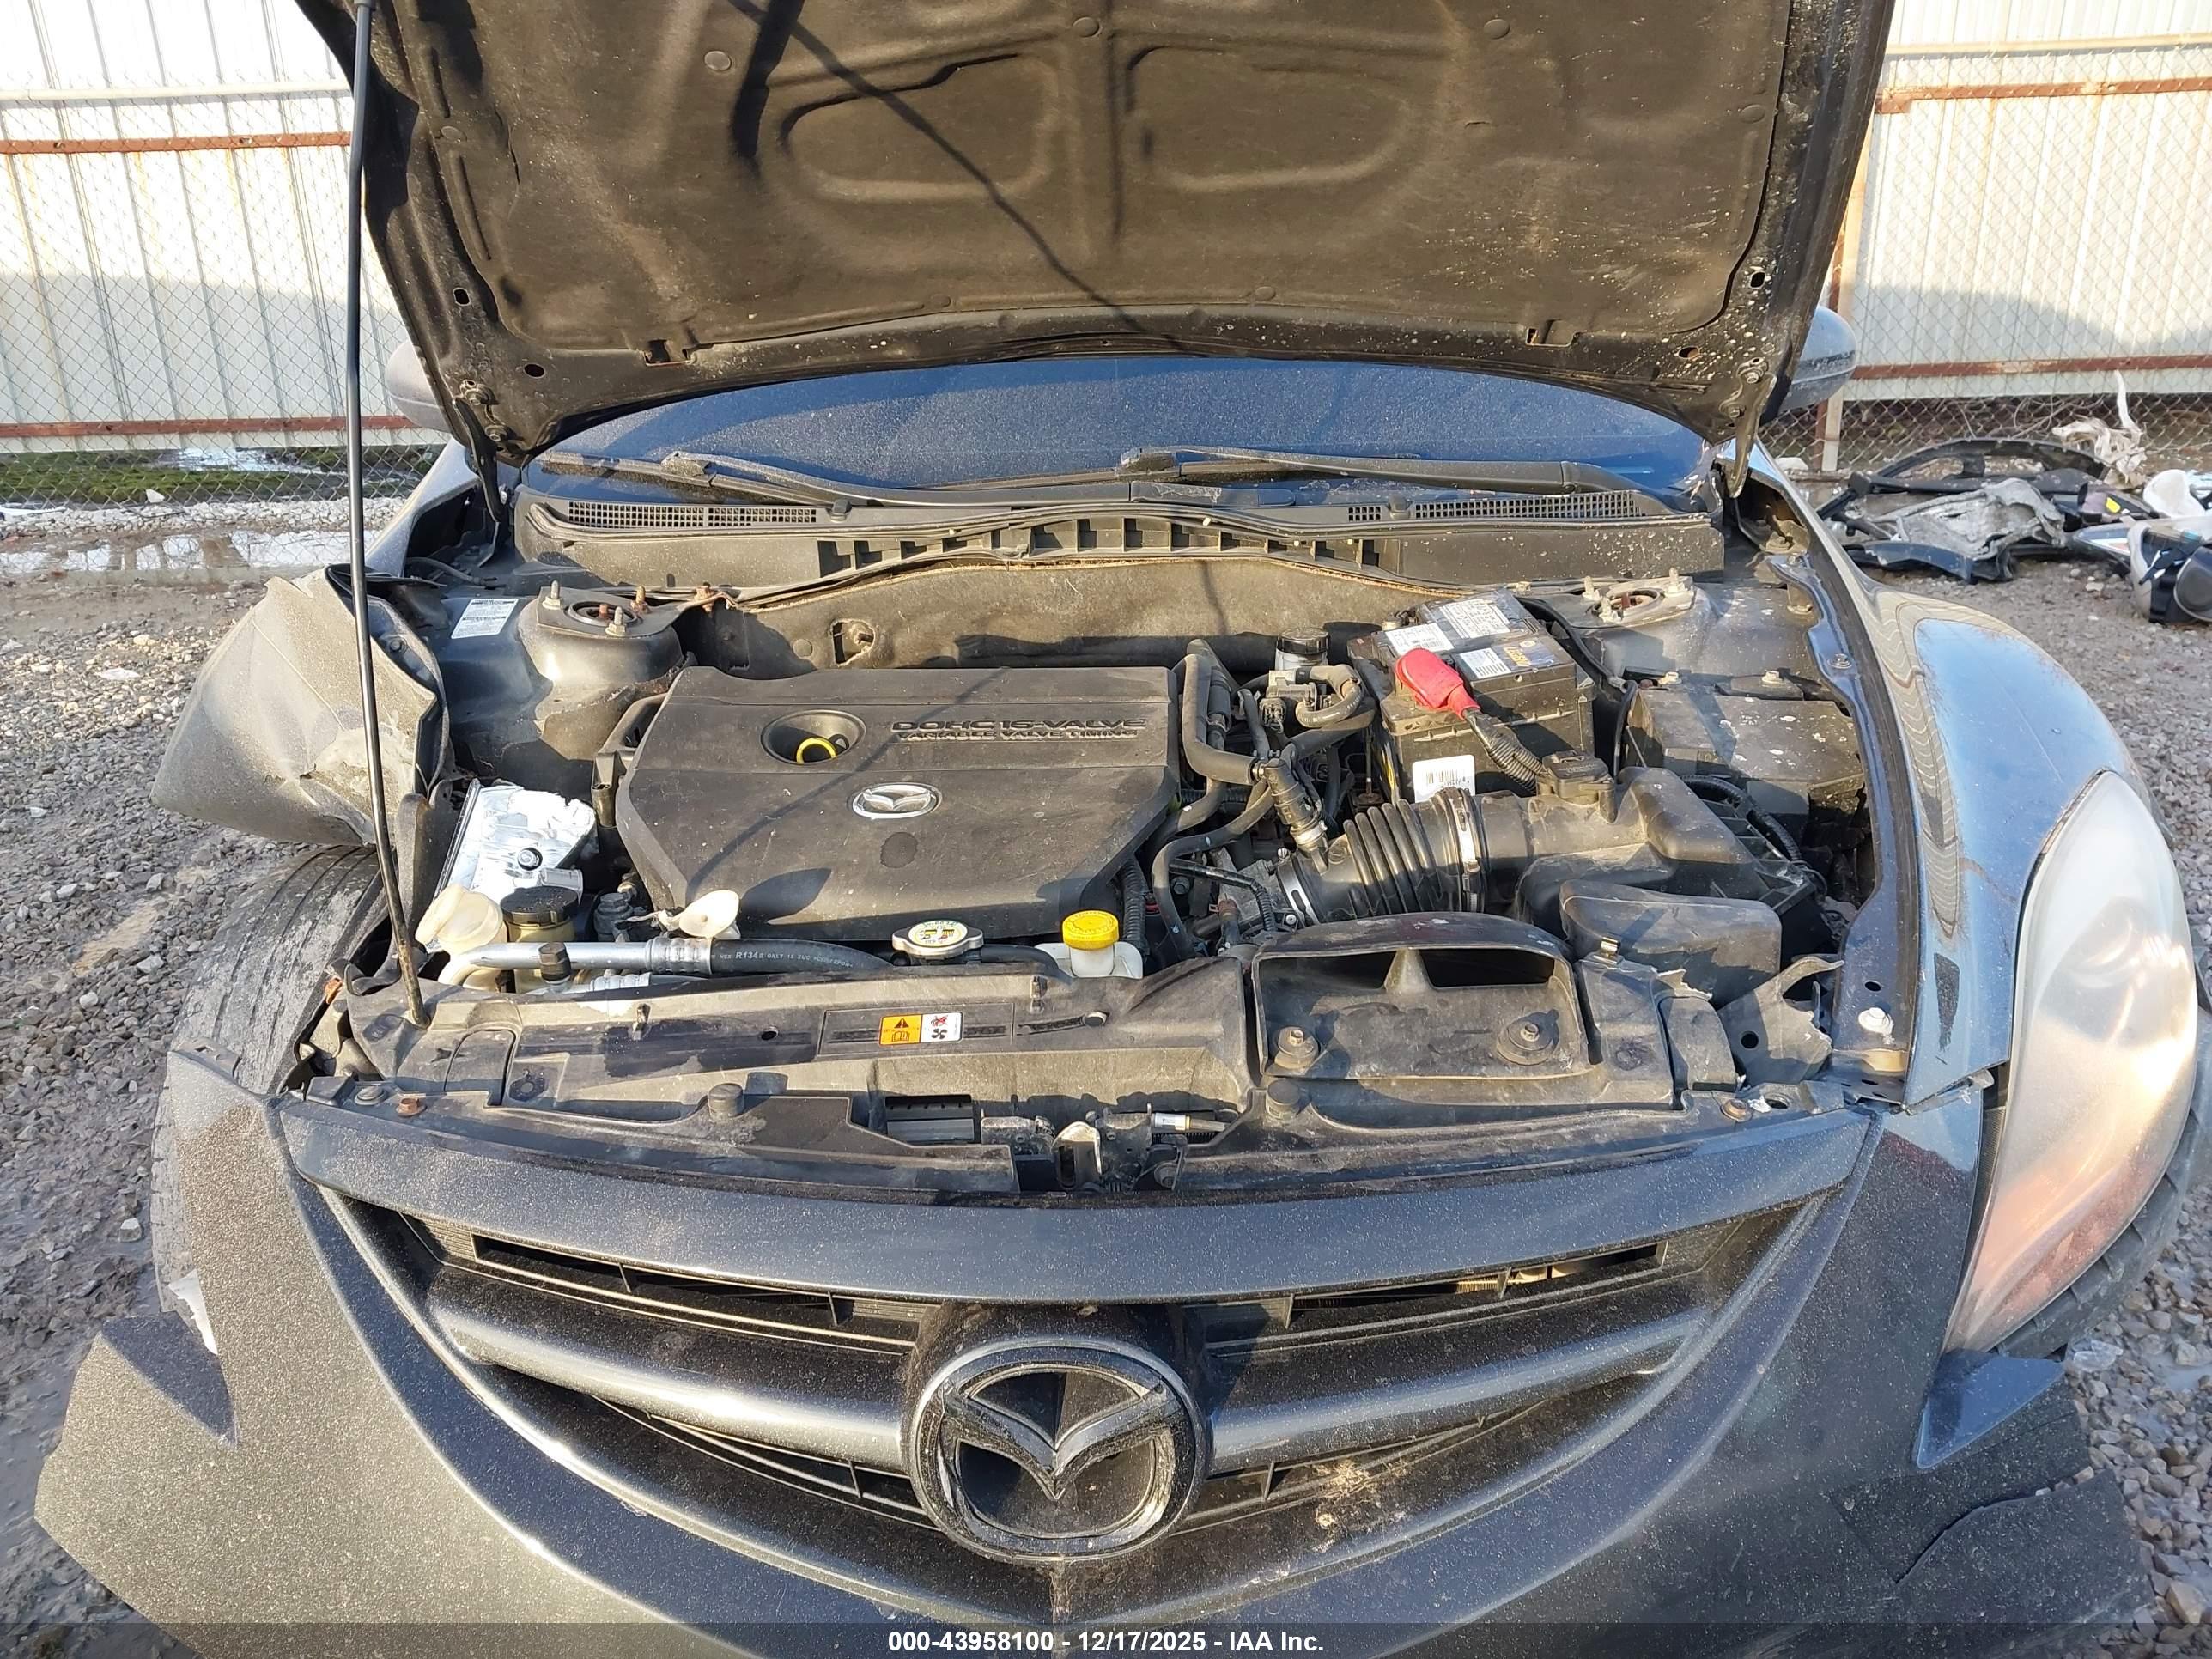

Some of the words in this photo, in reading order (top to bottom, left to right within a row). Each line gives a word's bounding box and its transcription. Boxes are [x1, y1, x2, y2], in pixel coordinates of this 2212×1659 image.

[891, 720, 996, 732] DOHC
[1000, 719, 1146, 731] 16-VALVE
[898, 732, 996, 741] VARIABLE
[1000, 731, 1065, 740] VALVE
[1065, 730, 1138, 739] TIMING
